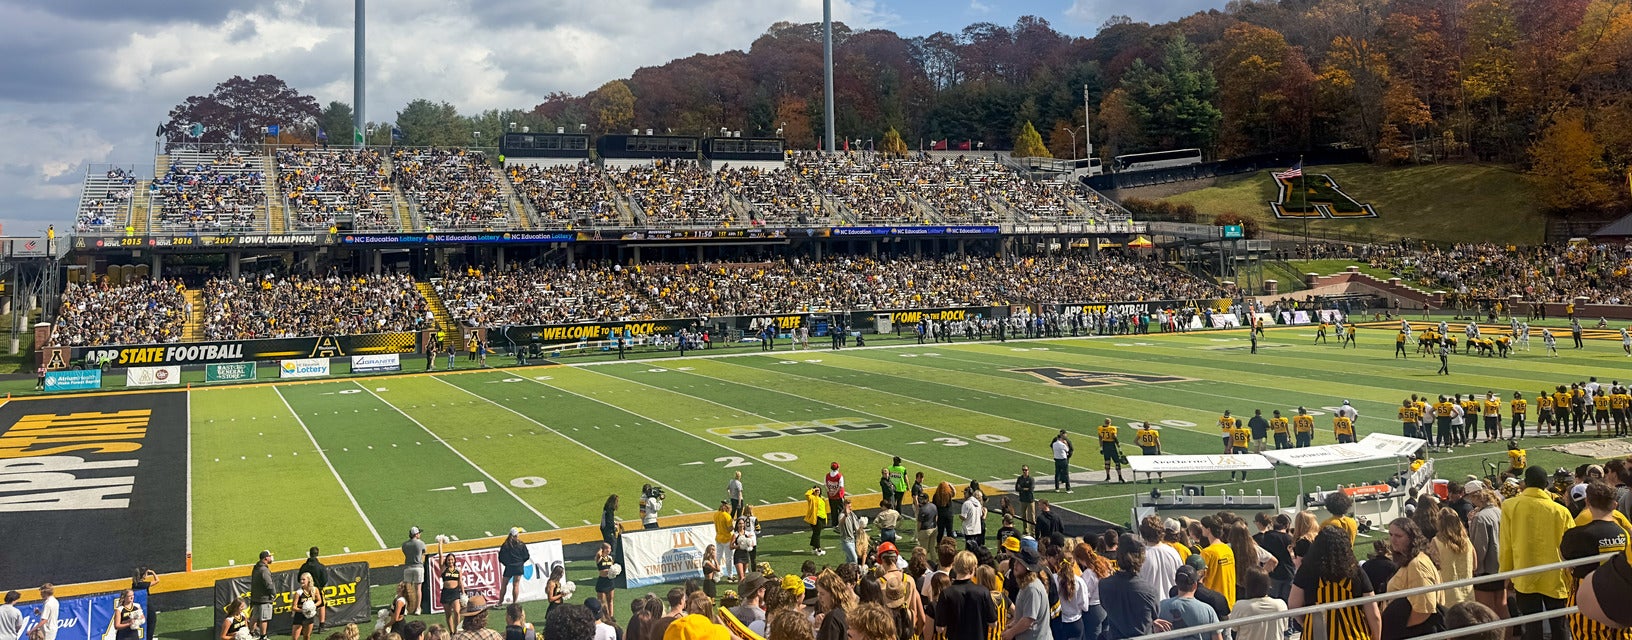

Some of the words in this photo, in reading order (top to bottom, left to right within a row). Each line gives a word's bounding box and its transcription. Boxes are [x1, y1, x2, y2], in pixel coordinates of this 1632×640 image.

[121, 238, 142, 246] 2015
[173, 237, 193, 245] 2016
[215, 236, 235, 245] 2017
[239, 235, 264, 244] BOWL
[267, 235, 317, 243] CHAMPIONS
[365, 235, 399, 243] Education
[399, 235, 423, 243] Lottery
[478, 234, 500, 242] Lottery
[940, 310, 965, 321] ROCK
[543, 326, 601, 340] WELCOME
[601, 327, 610, 335] TO
[119, 348, 165, 364] STATE
[166, 344, 243, 362] FOOTBALL
[1101, 431, 1111, 440] 73
[1142, 434, 1153, 443] 60
[1234, 432, 1246, 441] 66
[657, 554, 674, 564] LAW
[674, 551, 703, 562] OFFICES
[643, 561, 684, 575] TIMOTHY
